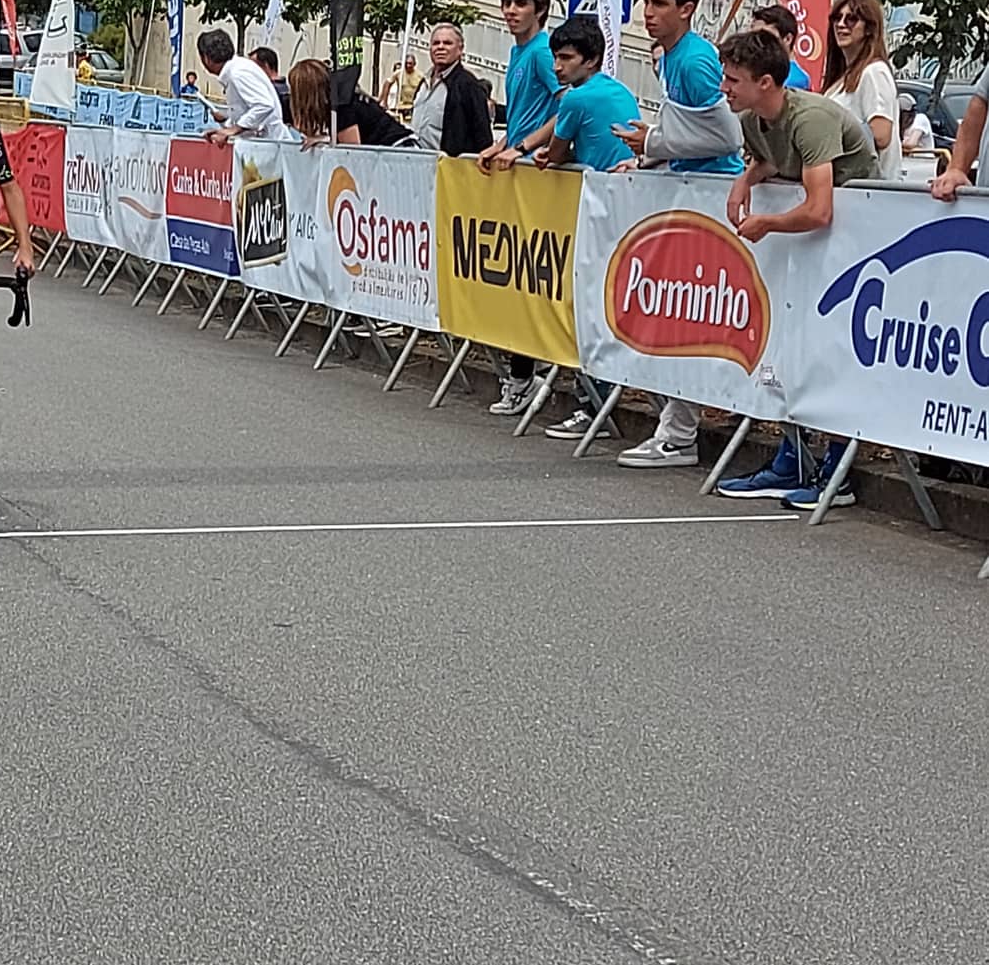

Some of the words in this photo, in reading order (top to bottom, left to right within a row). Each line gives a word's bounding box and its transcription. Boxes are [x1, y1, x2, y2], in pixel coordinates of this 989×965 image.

[336, 199, 431, 271] Osfama
[452, 215, 572, 302] MEDWAY
[622, 257, 750, 331] Porminho
[852, 277, 961, 375] Cruise
